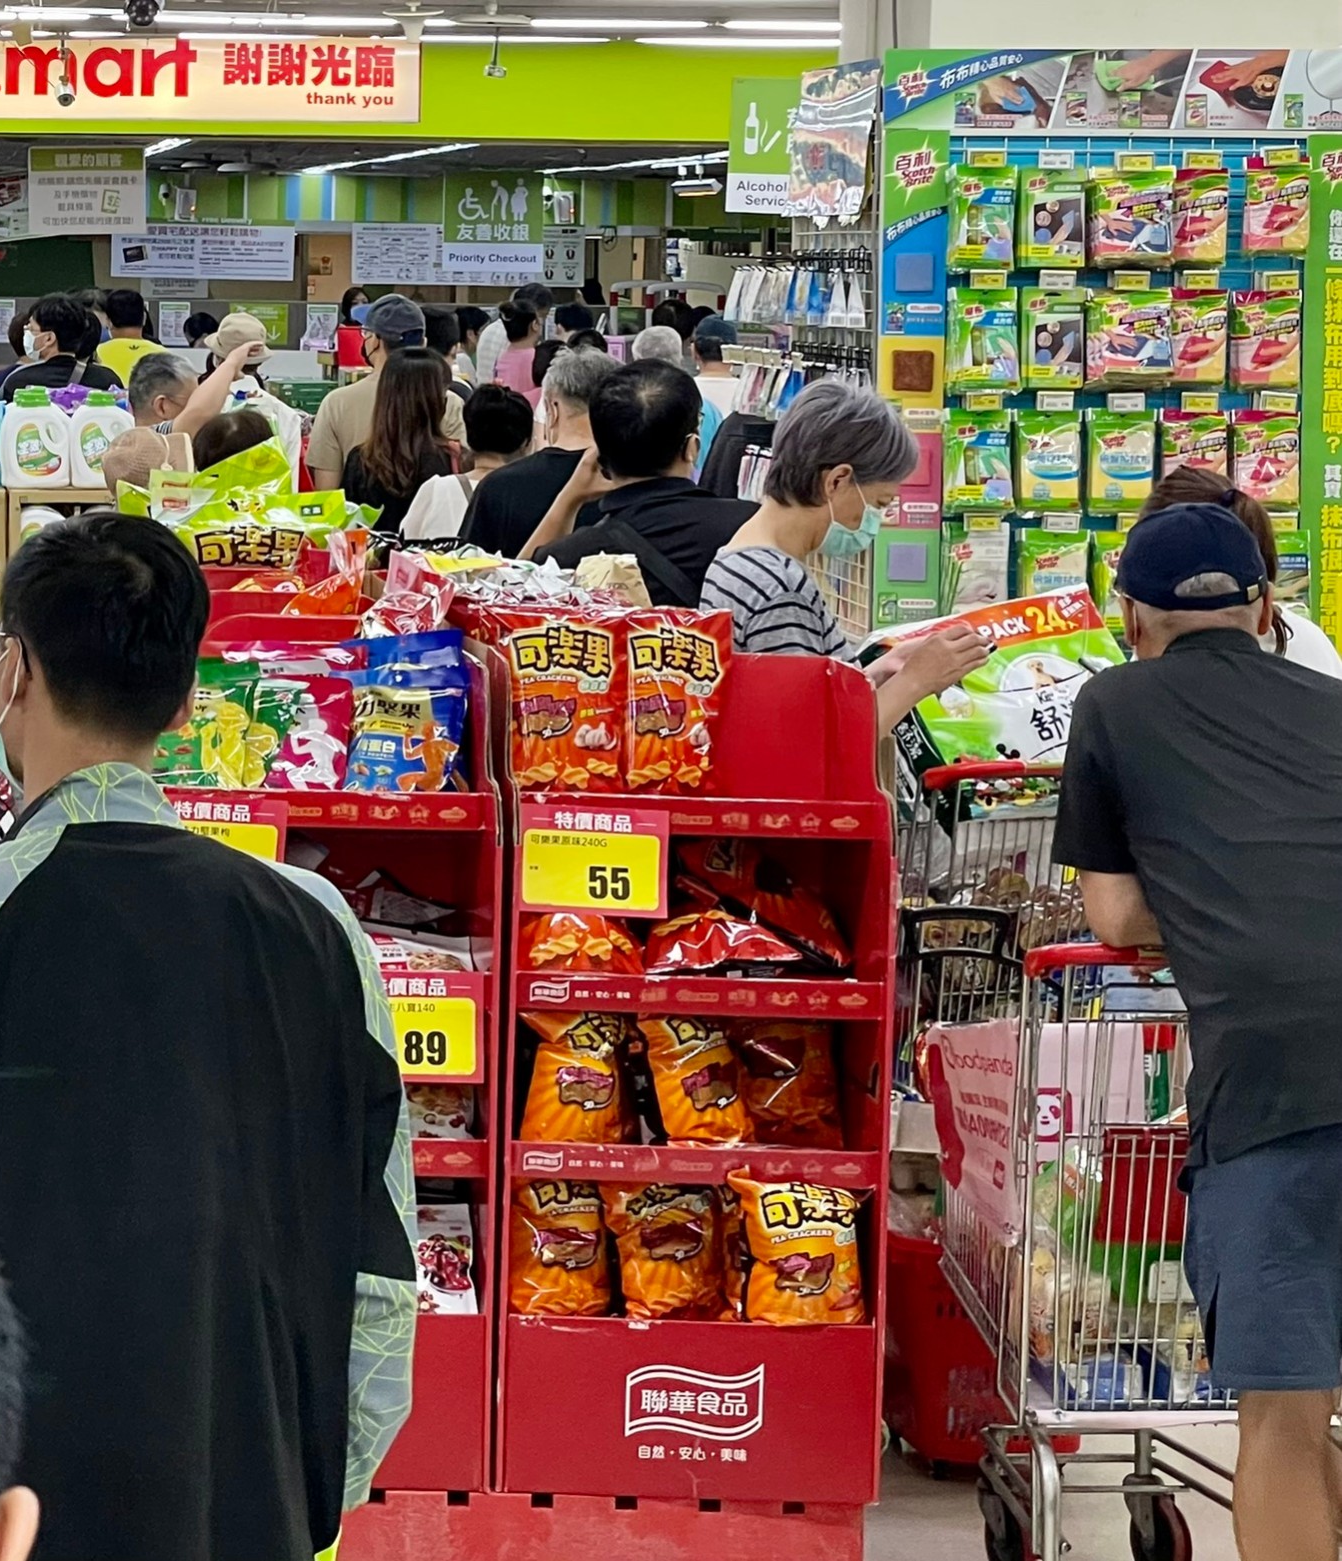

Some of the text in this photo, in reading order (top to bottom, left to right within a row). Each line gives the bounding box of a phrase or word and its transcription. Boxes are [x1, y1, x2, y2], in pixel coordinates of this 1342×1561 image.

[224, 43, 395, 88] 謝謝光臨
[306, 92, 394, 108] thank you
[896, 151, 930, 170] 百利
[901, 166, 936, 181] Scotch
[904, 175, 933, 188] Brite
[737, 181, 787, 192] Alcohol
[746, 195, 785, 206] Servic
[457, 224, 529, 241] 友善收銀
[449, 253, 536, 264] Priority Checkout
[978, 616, 1031, 643] PACK
[520, 675, 576, 685] PEA CRACKERS
[637, 676, 652, 685] PEA
[174, 802, 251, 821] 特價商品
[554, 811, 632, 833] 特價商品
[588, 866, 631, 900] 55
[404, 1031, 446, 1065] 89
[560, 1205, 598, 1213] CRACKER
[771, 1230, 833, 1244] PEA CRACKERS
[640, 1388, 748, 1417] 聯華食品
